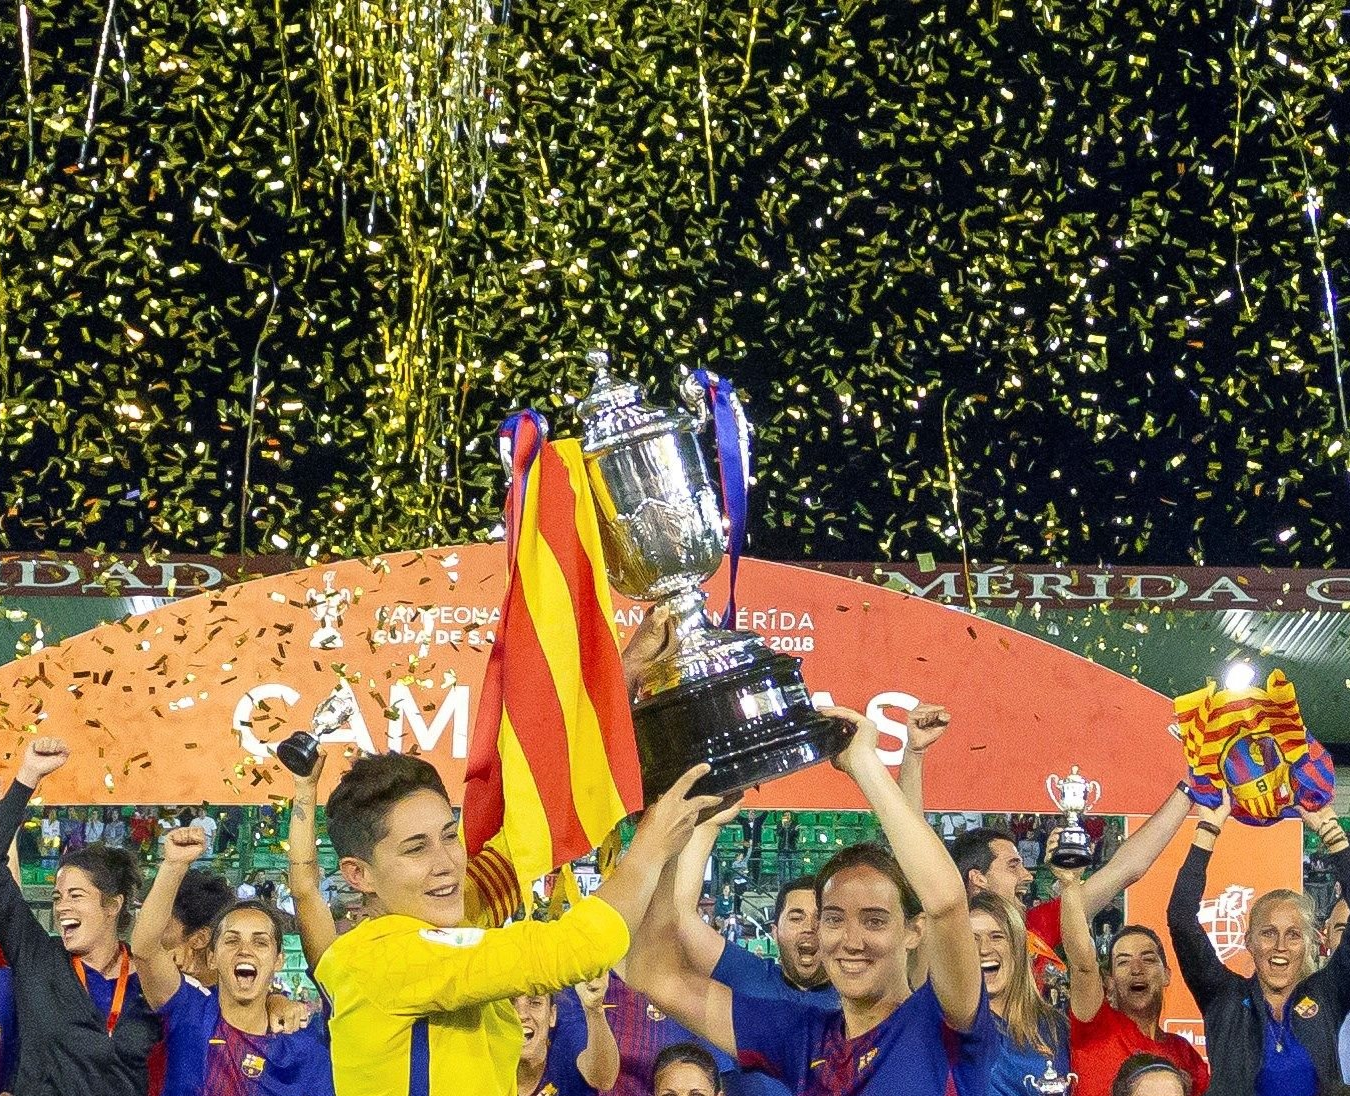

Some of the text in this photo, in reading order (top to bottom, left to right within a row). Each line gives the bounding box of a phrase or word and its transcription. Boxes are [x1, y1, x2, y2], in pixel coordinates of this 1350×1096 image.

[881, 562, 1258, 603] MÉRIDA
[374, 605, 500, 625] CAMPEONA
[435, 629, 463, 645] DE
[771, 636, 815, 652] 2018
